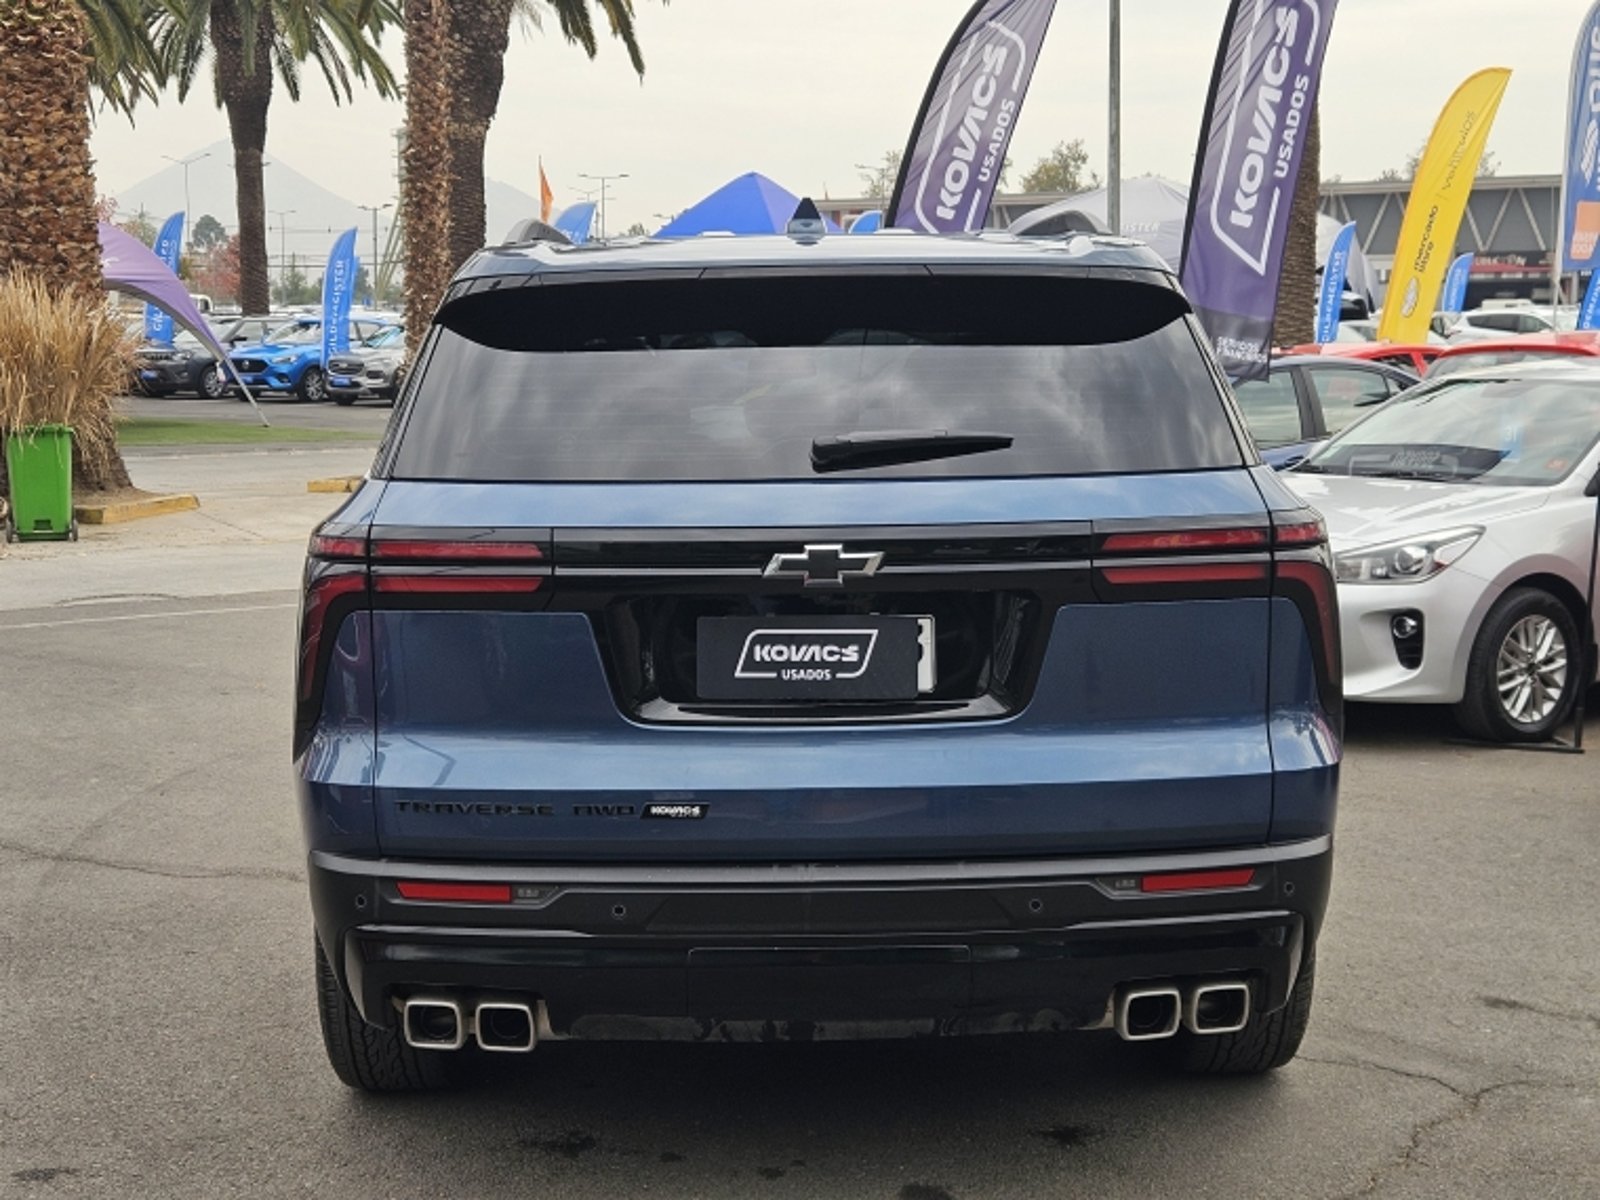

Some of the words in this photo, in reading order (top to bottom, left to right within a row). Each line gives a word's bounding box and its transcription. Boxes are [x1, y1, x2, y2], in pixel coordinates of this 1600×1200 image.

[936, 42, 1007, 220] KOVACS
[978, 98, 1016, 184] USADOS
[1229, 4, 1300, 229] KOVACS
[1273, 74, 1309, 179] USADOS
[753, 643, 860, 662] KOVACS
[781, 668, 832, 680] USADOS
[395, 801, 554, 816] TRAVERSE
[572, 804, 635, 816] AWD
